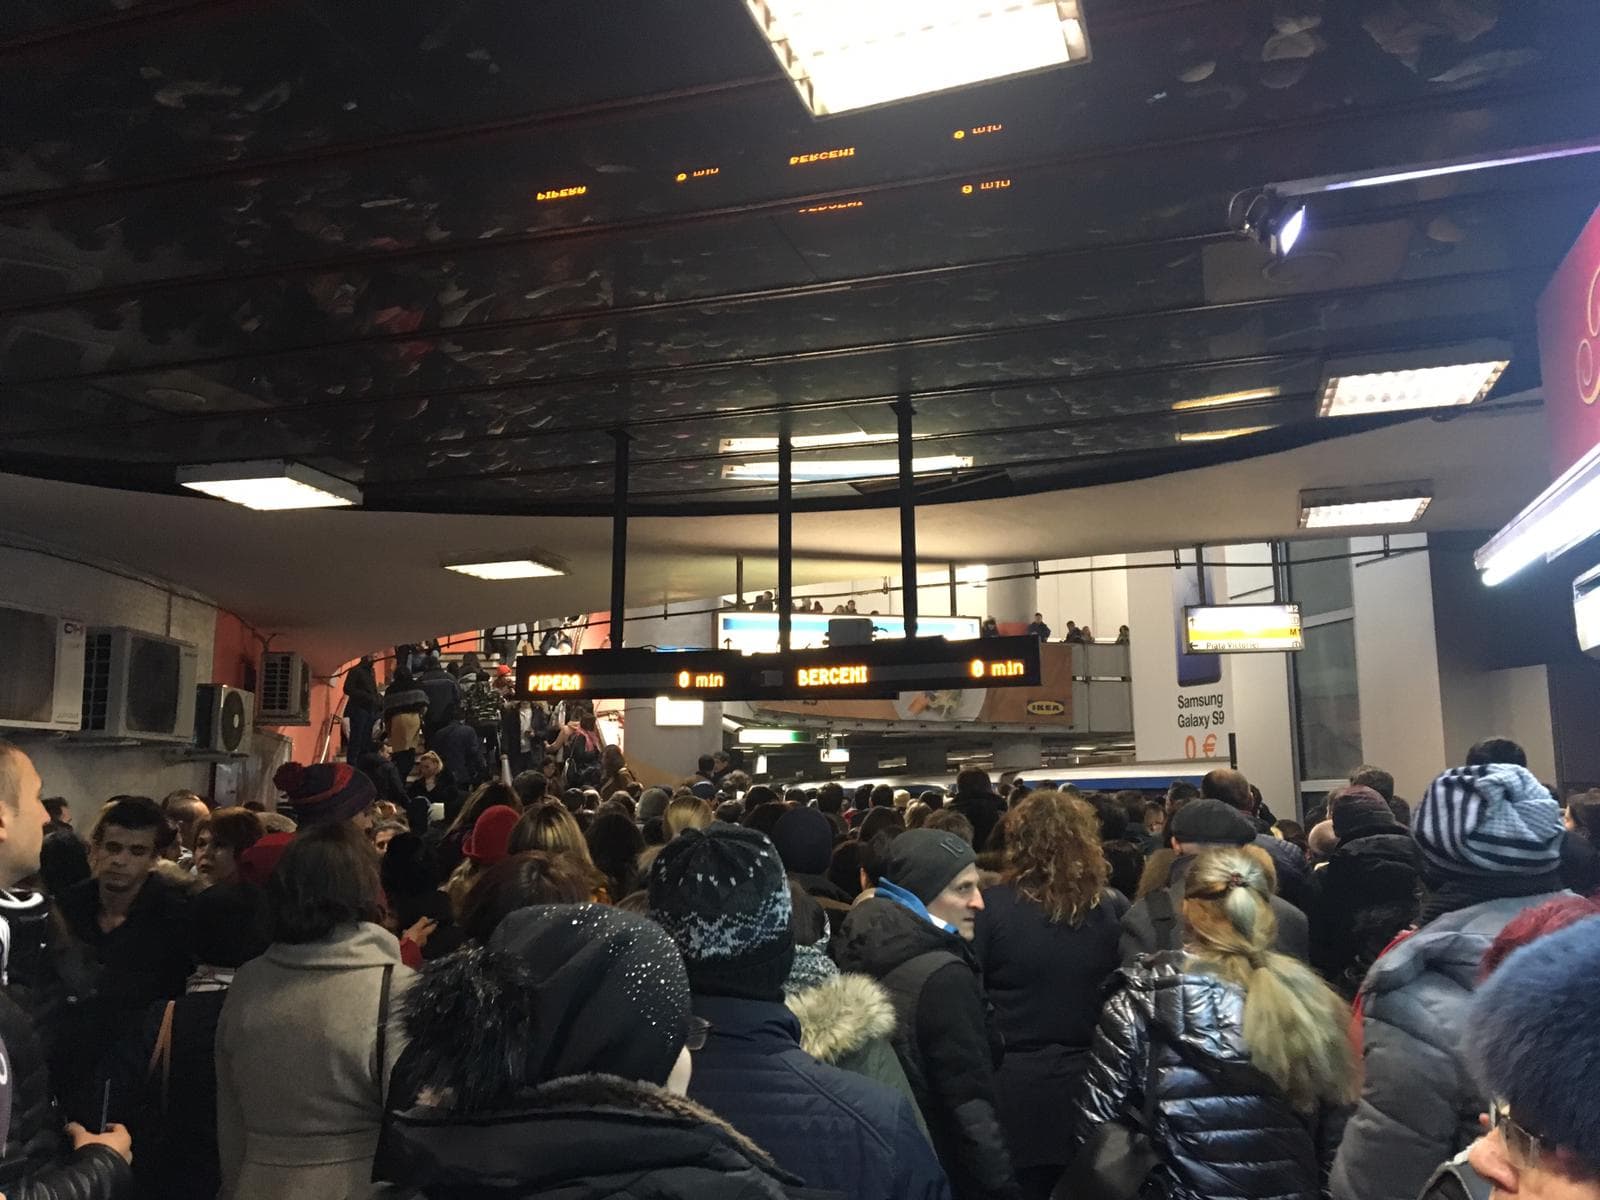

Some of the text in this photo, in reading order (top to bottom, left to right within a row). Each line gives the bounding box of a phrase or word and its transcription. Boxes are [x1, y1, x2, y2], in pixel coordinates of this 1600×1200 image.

[990, 660, 1025, 677] min
[528, 673, 582, 692] PIPERA
[695, 672, 724, 688] min
[1031, 704, 1060, 712] IKEA
[1177, 693, 1224, 709] Samsung
[1177, 710, 1225, 729] Galaxy S9
[1185, 733, 1218, 759] 0 €
